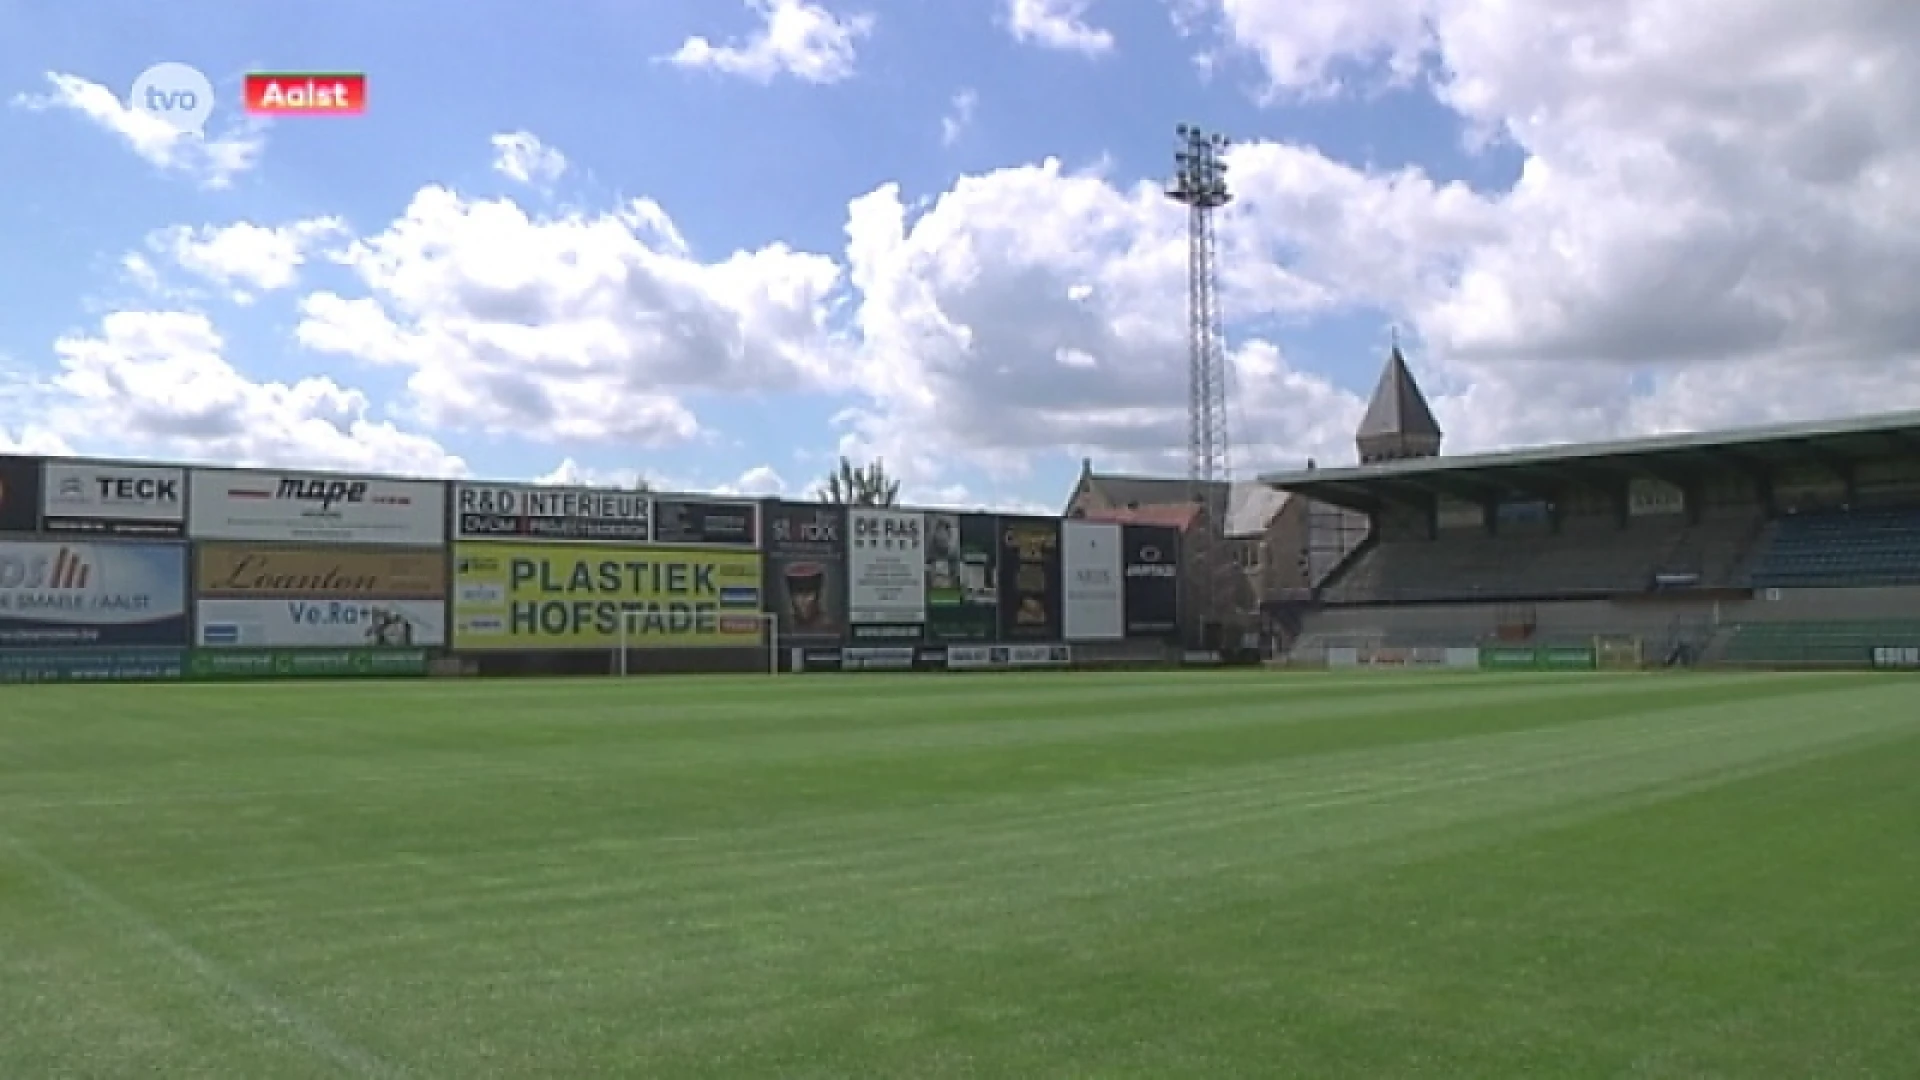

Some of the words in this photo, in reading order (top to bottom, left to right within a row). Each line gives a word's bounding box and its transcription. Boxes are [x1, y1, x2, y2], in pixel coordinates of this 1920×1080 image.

[96, 476, 178, 503] TECK
[461, 488, 516, 514] R&D
[855, 516, 879, 535] DE
[884, 517, 920, 538] RAS
[510, 558, 716, 595] PLASTIEK
[510, 601, 717, 635] HOFSTADE
